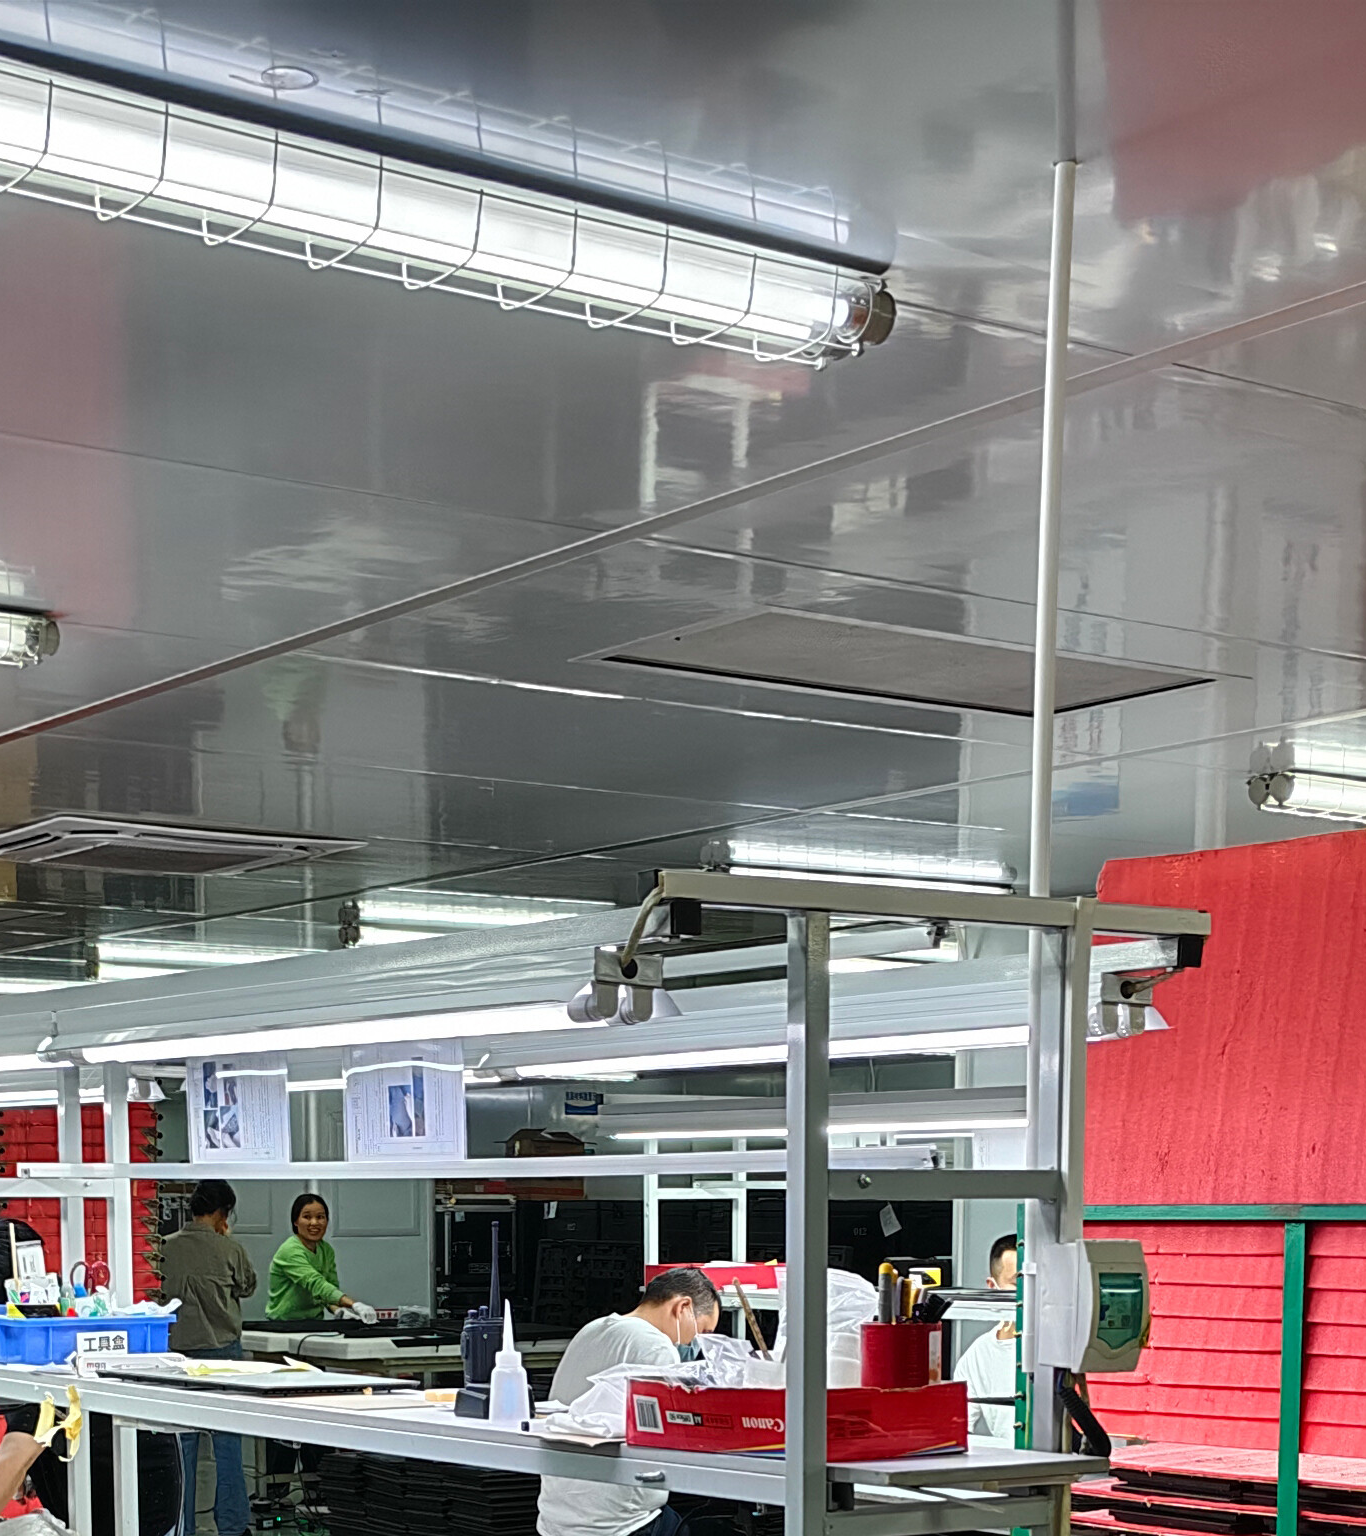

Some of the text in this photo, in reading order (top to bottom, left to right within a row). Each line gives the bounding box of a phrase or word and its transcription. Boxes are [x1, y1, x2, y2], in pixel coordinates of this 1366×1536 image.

[83, 1335, 125, 1352] 工具盒
[742, 1416, 785, 1432] Canon
